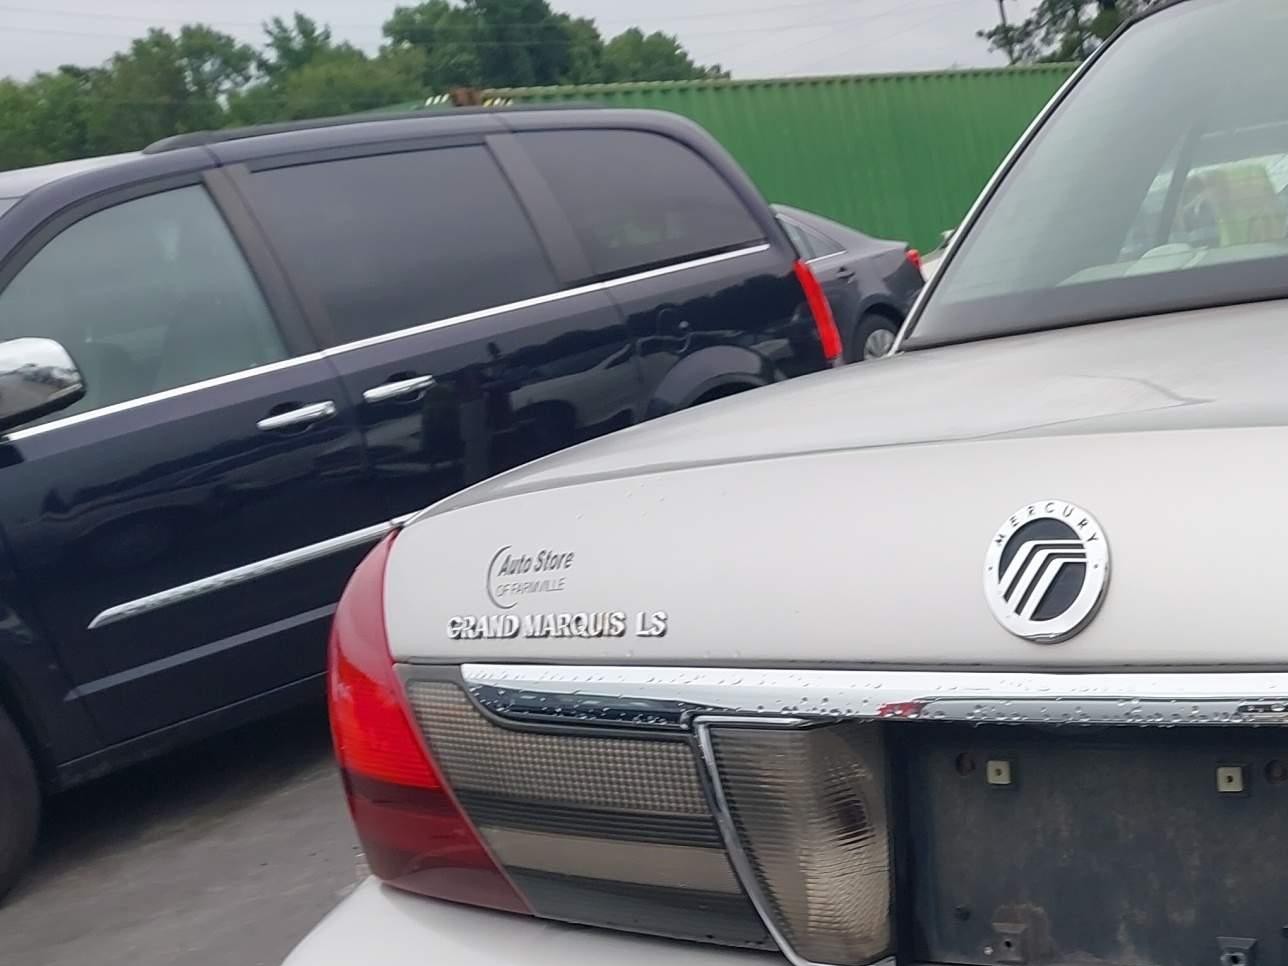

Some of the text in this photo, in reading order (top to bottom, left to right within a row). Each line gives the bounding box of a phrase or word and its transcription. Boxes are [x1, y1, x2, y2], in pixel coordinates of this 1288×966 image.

[995, 502, 1099, 545] MERCURY
[497, 549, 576, 577] Auto Store
[447, 610, 669, 640] GRAND MARQUIS LS
